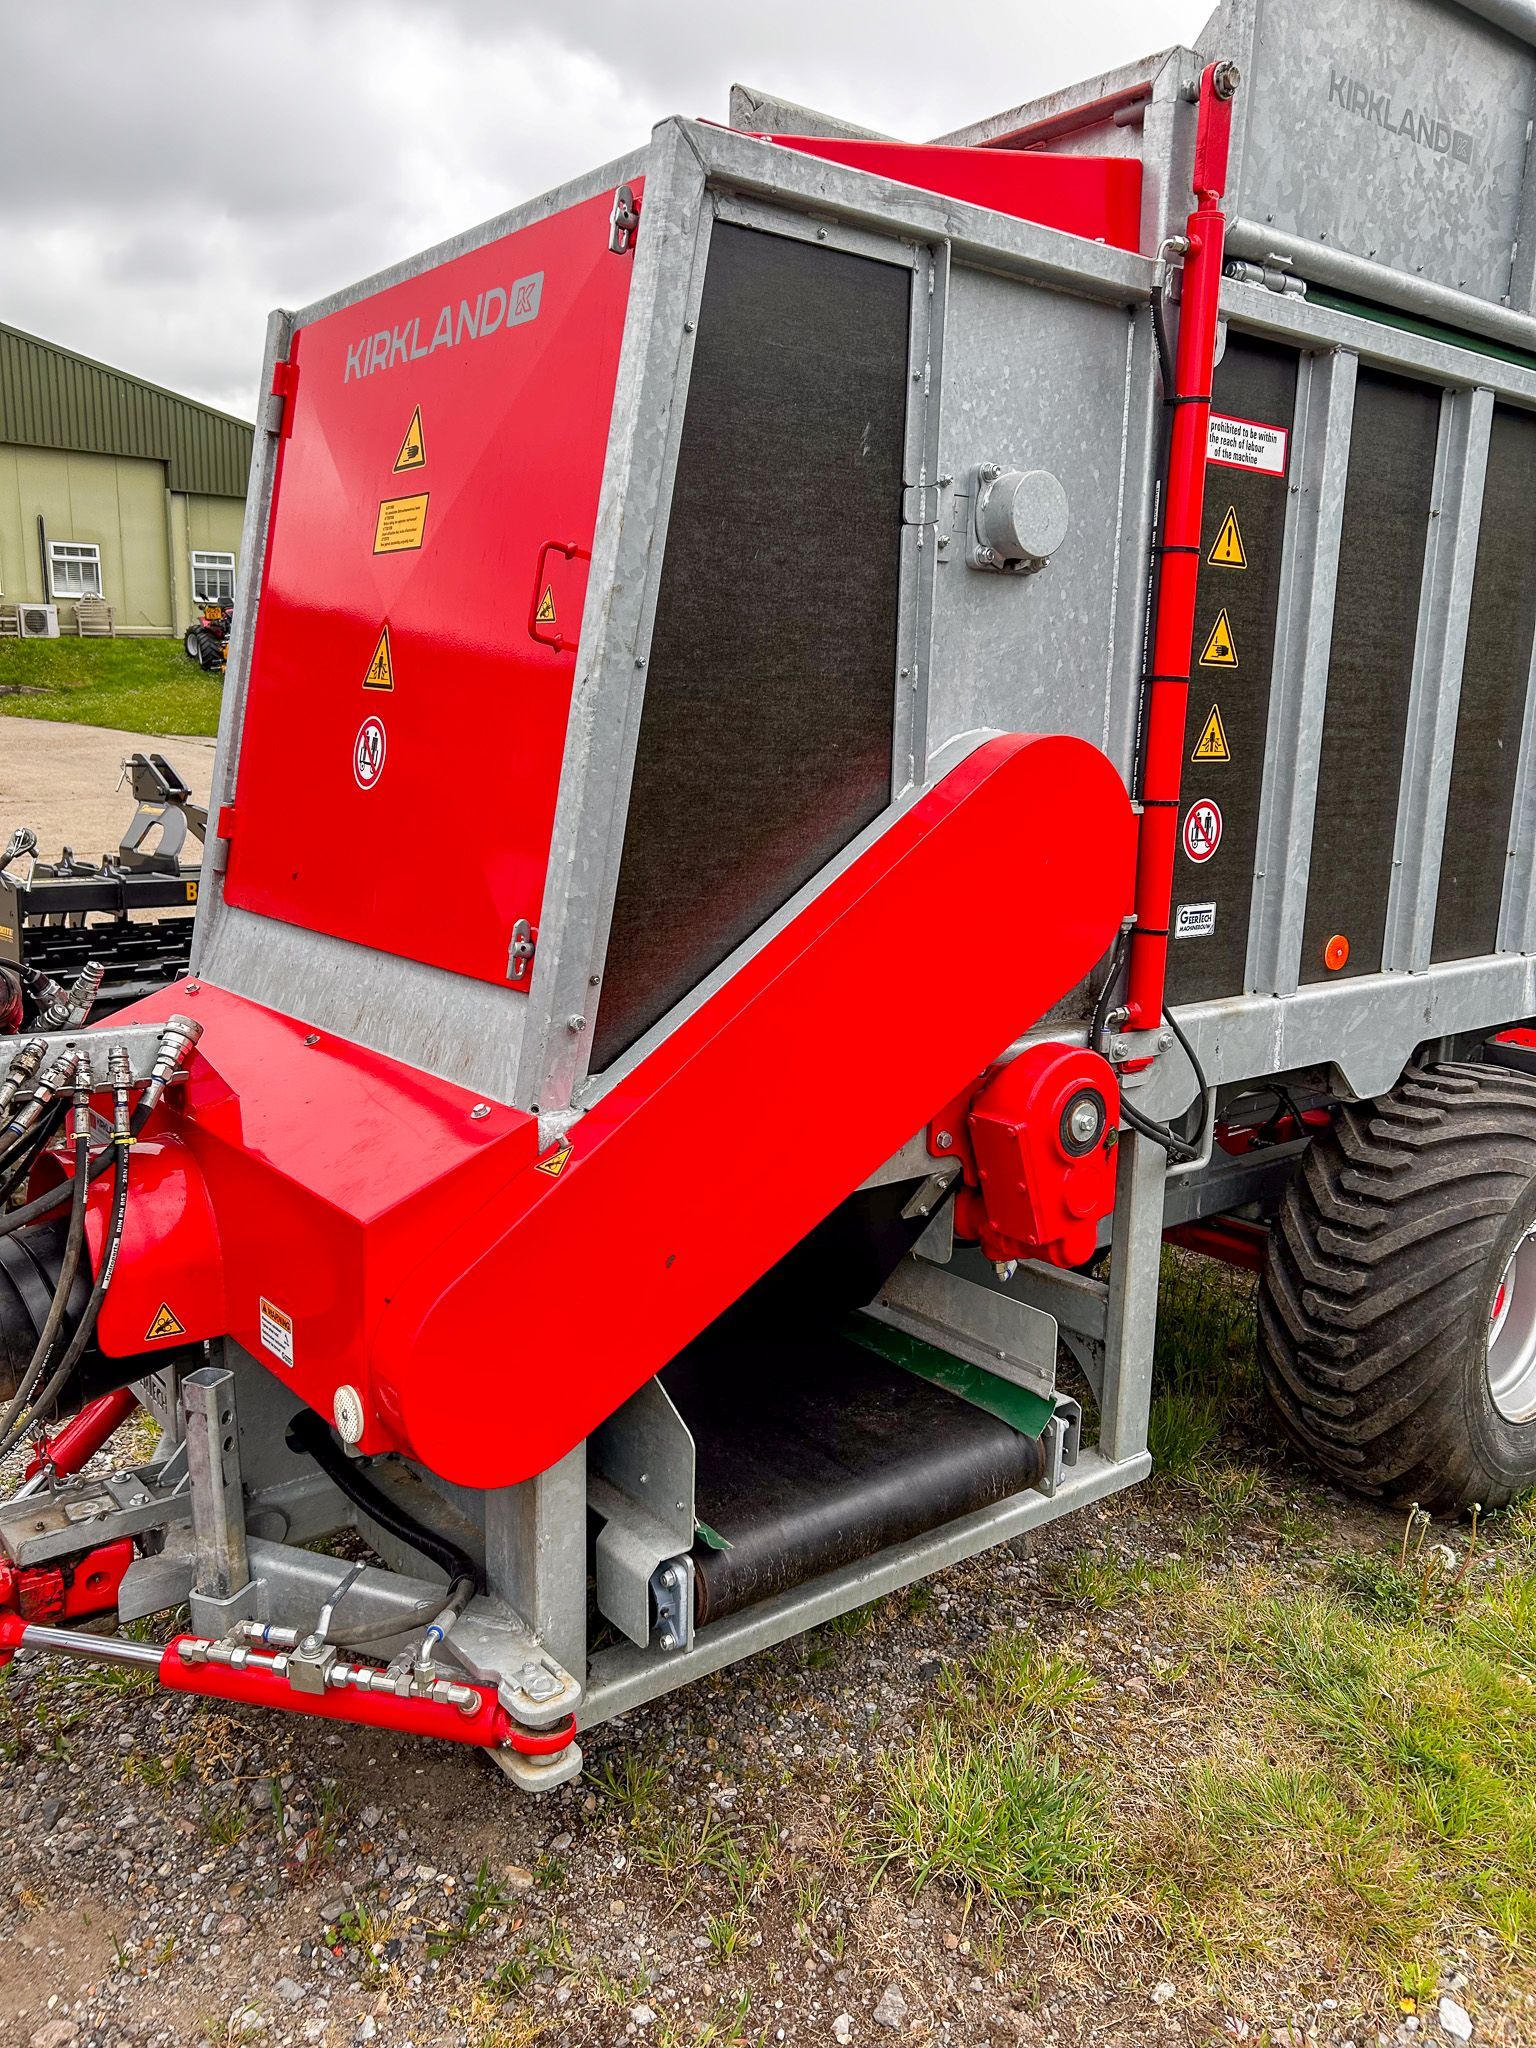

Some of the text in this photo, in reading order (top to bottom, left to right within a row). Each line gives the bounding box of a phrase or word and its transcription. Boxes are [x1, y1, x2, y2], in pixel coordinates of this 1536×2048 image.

[1329, 70, 1451, 154] KIRKLAND
[344, 287, 507, 384] KIRKLAND
[1209, 432, 1265, 453] the reach of labour
[1210, 421, 1277, 444] prohibited to be within
[1214, 446, 1258, 465] of the machine
